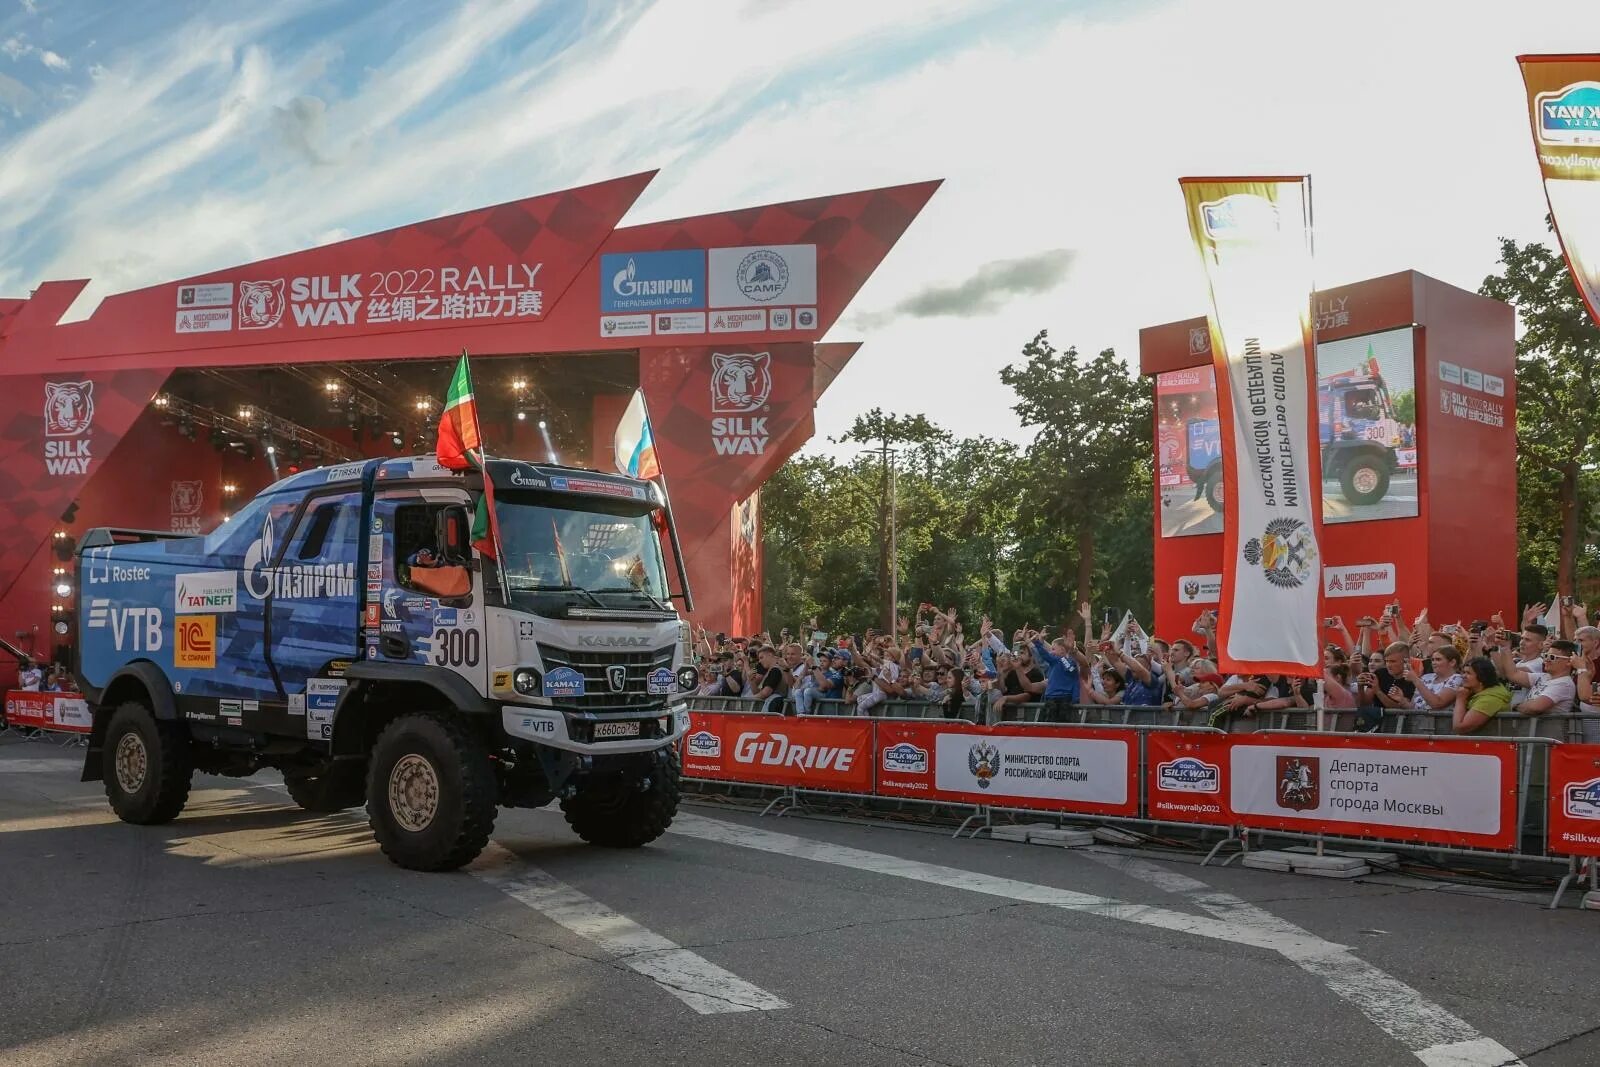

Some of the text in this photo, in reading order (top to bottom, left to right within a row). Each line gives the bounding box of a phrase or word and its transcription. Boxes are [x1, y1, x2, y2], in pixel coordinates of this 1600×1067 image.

[290, 262, 543, 301] SILK 2022 RALLY
[636, 278, 693, 296] ГАЗПРОМ
[367, 290, 542, 323] 丝绸之路拉力赛
[613, 298, 662, 308] ГЕНЕРАЛЬНЫЙ
[290, 299, 363, 328] WAY
[1451, 392, 1468, 407] SILK
[1482, 400, 1504, 415] RALLY
[1452, 405, 1468, 418] WAY
[712, 416, 769, 436] SILK
[45, 440, 92, 458] SILK
[712, 436, 769, 456] WAY
[45, 457, 92, 475] WAY
[171, 516, 201, 529] SILK
[113, 566, 151, 582] Rostec
[274, 562, 354, 599] ГАЗПРОМ
[1344, 570, 1388, 581] МОСКОВСКИЙ
[1344, 582, 1366, 591] СПОРТ
[188, 595, 234, 607] TATNEFT
[111, 607, 164, 652] VTB
[436, 628, 480, 667] 300
[578, 635, 653, 647] KAMAZ
[533, 720, 555, 733] VTB
[888, 752, 923, 761] SILK WAY
[1004, 753, 1081, 767] МИНИСТЕРСТВО СПОРТА
[1004, 766, 1088, 782] РОССИЙСКОЙ ФЕДЕРАЦИИ
[1164, 769, 1215, 778] SILK WAY
[1329, 759, 1429, 777] Департамент
[1329, 778, 1379, 794] спорта
[1573, 791, 1600, 802] SIL
[1157, 802, 1221, 813] #silkwayrally2022
[1329, 796, 1444, 816] города Москвы
